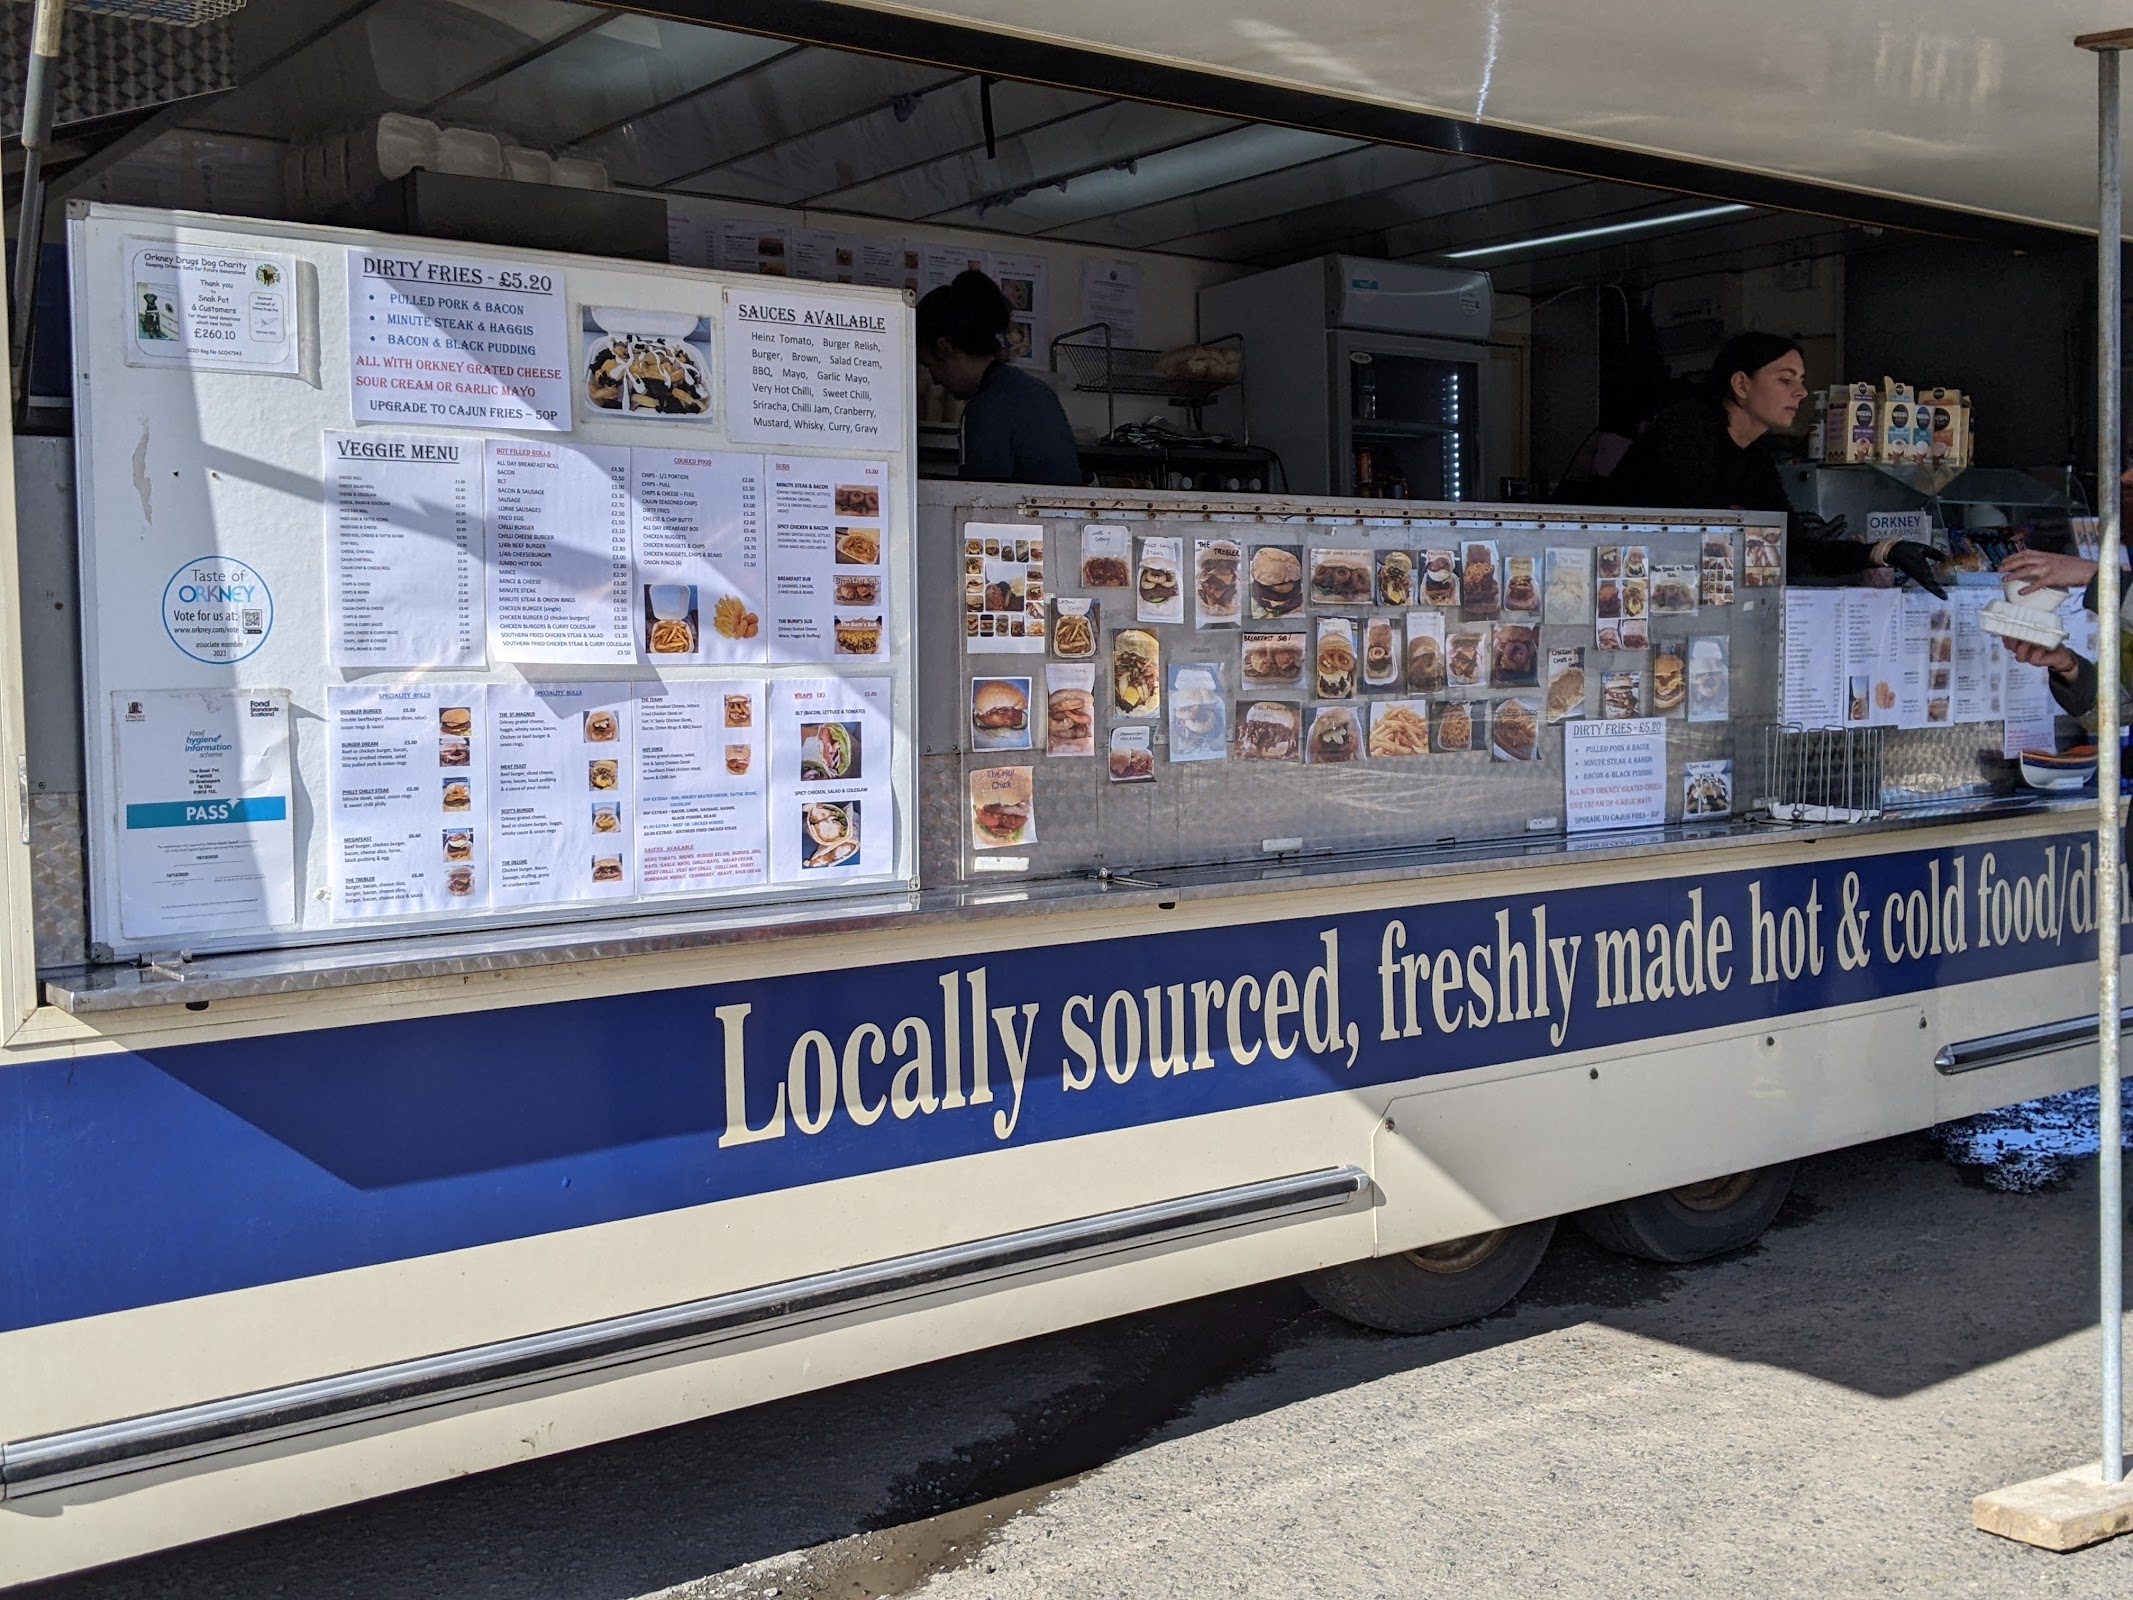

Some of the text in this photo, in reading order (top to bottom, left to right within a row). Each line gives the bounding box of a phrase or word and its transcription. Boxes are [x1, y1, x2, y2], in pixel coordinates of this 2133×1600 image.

[144, 253, 173, 264] Orkney
[176, 256, 199, 266] Drugs
[201, 258, 216, 268] Dog
[218, 260, 247, 271] Charity
[200, 279, 220, 288] Thank
[363, 257, 552, 292] DIRTY FRIES £5.20
[198, 295, 216, 303] Snak
[390, 294, 524, 315] PULLED PORK & BACON
[199, 305, 236, 314] Customers
[738, 304, 886, 331] SAUCES AVAILABLE
[387, 313, 534, 336] MINUTE STEAK & HAGGIS
[194, 328, 236, 340] £260.10
[751, 332, 881, 353] Heinz Tomato, Burger Relish,
[387, 334, 536, 356] BACON & BLACK PUDDING
[356, 356, 562, 380] ALL WITH ORKNEY GRATED CHEESE
[752, 349, 882, 369] Burger, Brown, Salad Cream,
[752, 366, 870, 385] BBQ, Mayo, Garlic Mayo,
[356, 376, 535, 397] SOUR CREAM OR GARLIC MAYO
[753, 383, 872, 401] Very Hot Chilli, Sweet Chilli,
[370, 399, 557, 421] UPGRADE TO CAJUN FRIES 50P
[753, 400, 877, 419] Sriracha, Chilli Jam, Cranberry,
[753, 417, 878, 435] Mustard, Whisky, Curry, Gravy
[337, 439, 459, 461] VEGGIE MENU
[1870, 516, 1920, 528] ORKNEY
[1214, 548, 1240, 557] TREBLER
[191, 569, 246, 582] Taste of
[179, 585, 255, 602] ORKNEY
[174, 610, 238, 621] Vote for us at:
[1573, 721, 1661, 736] DIRTY FRIES £5.20
[185, 744, 232, 752] information
[186, 736, 219, 744] hygiene
[1585, 745, 1608, 753] PULLED
[186, 804, 228, 820] PASS
[1575, 815, 1601, 824] UPGRADE
[1610, 813, 1630, 821] CAJUN
[715, 965, 1040, 1148] Locally
[1061, 927, 1360, 1093] sourced,
[1378, 903, 1582, 1048] freshly
[1595, 887, 1733, 1012] made
[1748, 876, 1825, 986] hot
[1837, 870, 1872, 972] &
[1881, 854, 1968, 964] cold
